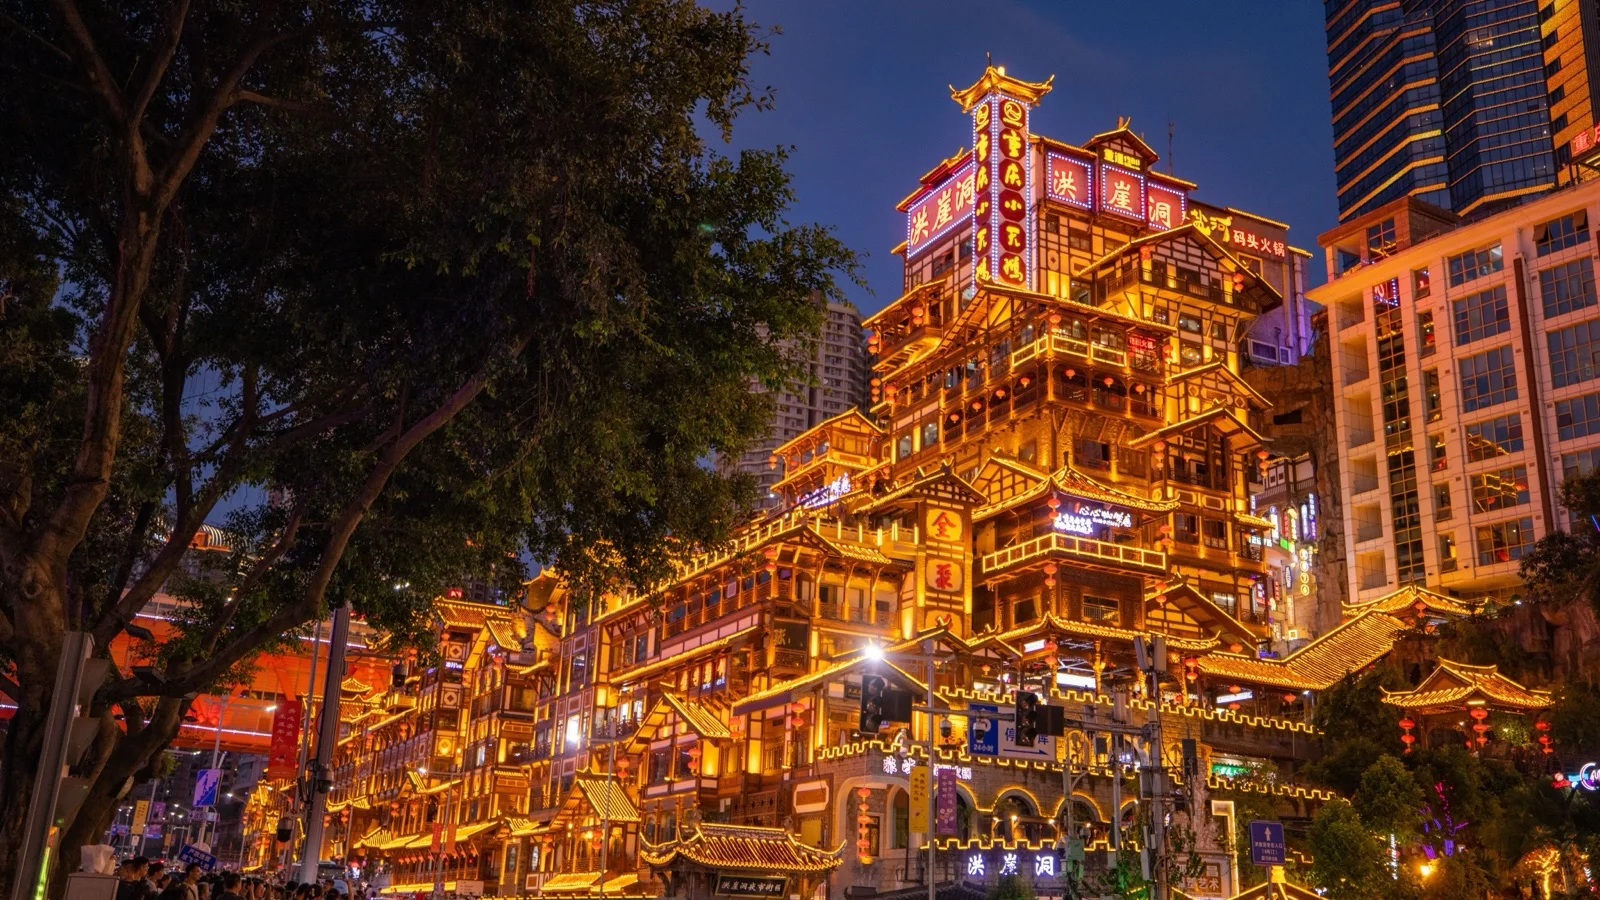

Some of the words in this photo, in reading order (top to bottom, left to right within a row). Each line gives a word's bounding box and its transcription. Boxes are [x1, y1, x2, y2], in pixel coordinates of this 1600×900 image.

[910, 173, 975, 247] 洪崖洞
[1002, 130, 1023, 282] 重庆小天鹅
[1053, 169, 1171, 229] 洪崖洞
[1233, 229, 1285, 257] 码头火锅
[973, 744, 994, 753] 24小时
[1005, 727, 1049, 746] 停库
[967, 853, 1054, 876] 洪崖洞
